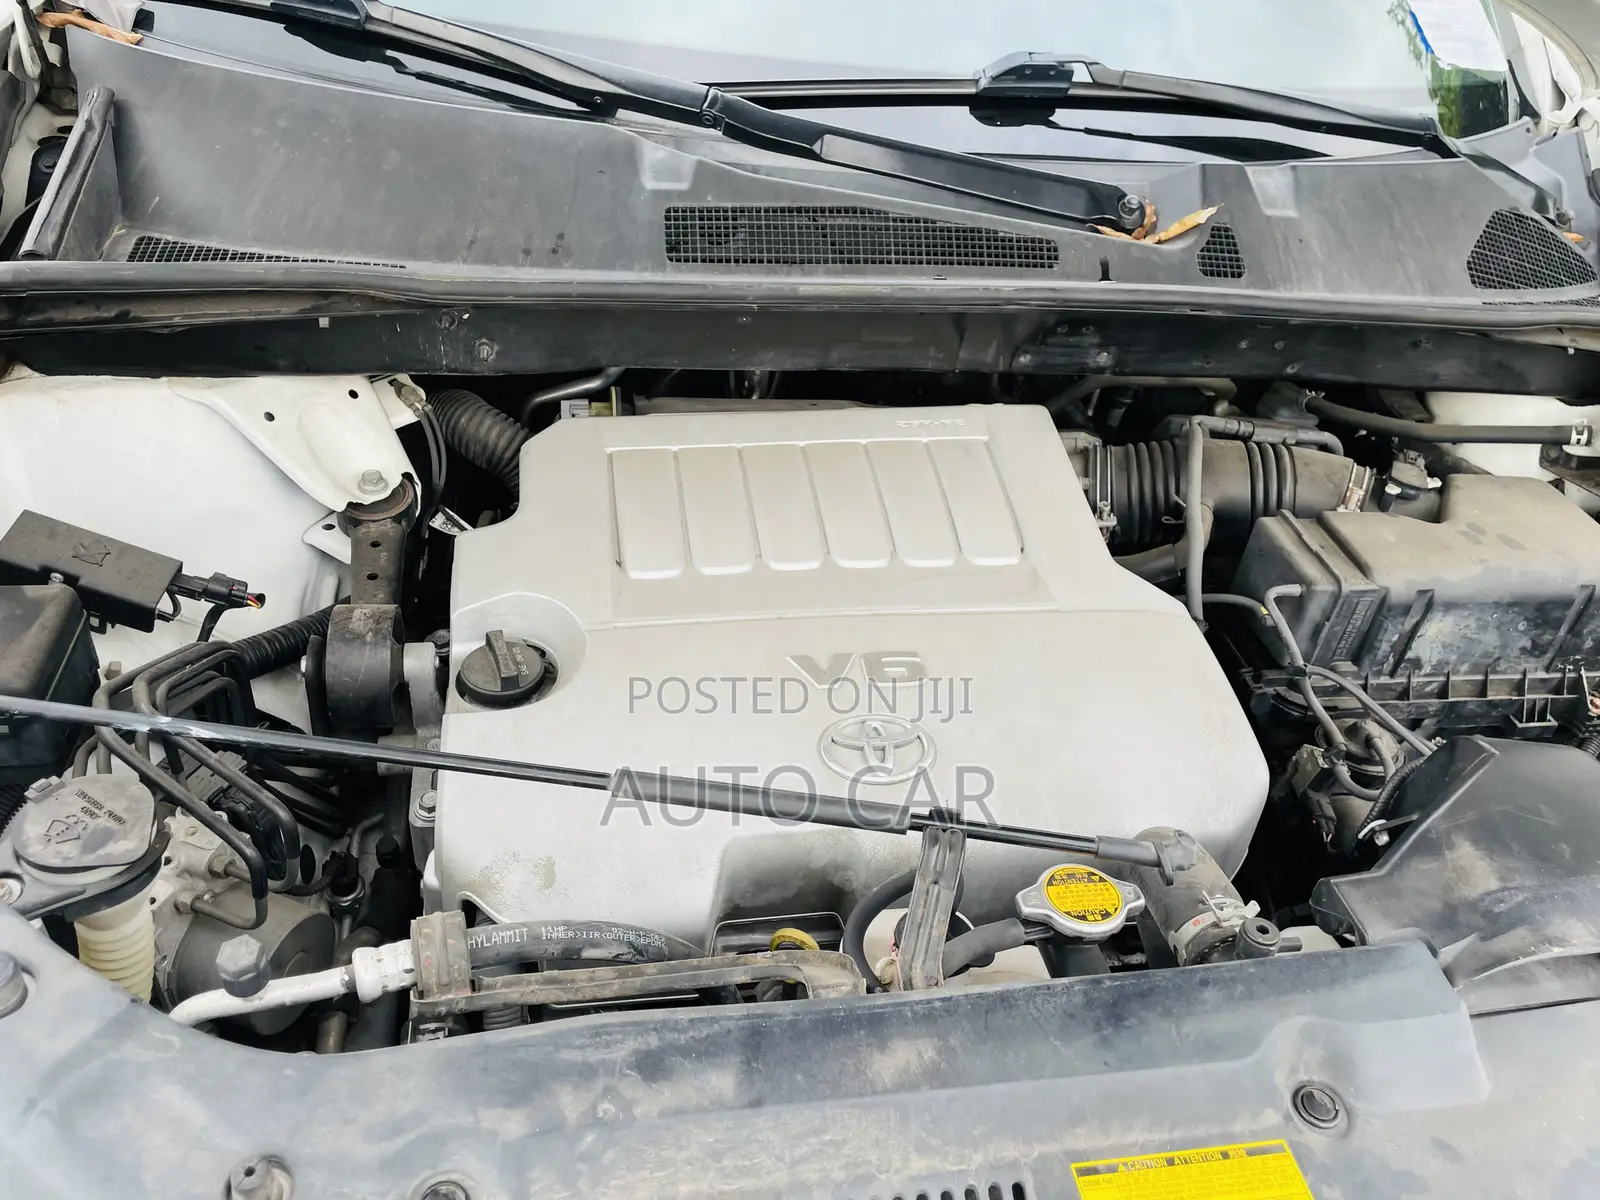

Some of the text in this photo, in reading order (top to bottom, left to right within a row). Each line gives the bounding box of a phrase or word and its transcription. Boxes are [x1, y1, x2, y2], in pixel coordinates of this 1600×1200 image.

[518, 663, 530, 676] SAE
[785, 651, 929, 690] V6
[1071, 909, 1106, 917] CAUTION
[467, 927, 529, 950] HYLAMMIT
[1127, 1151, 1223, 1172] CAUTION ATTENTION
